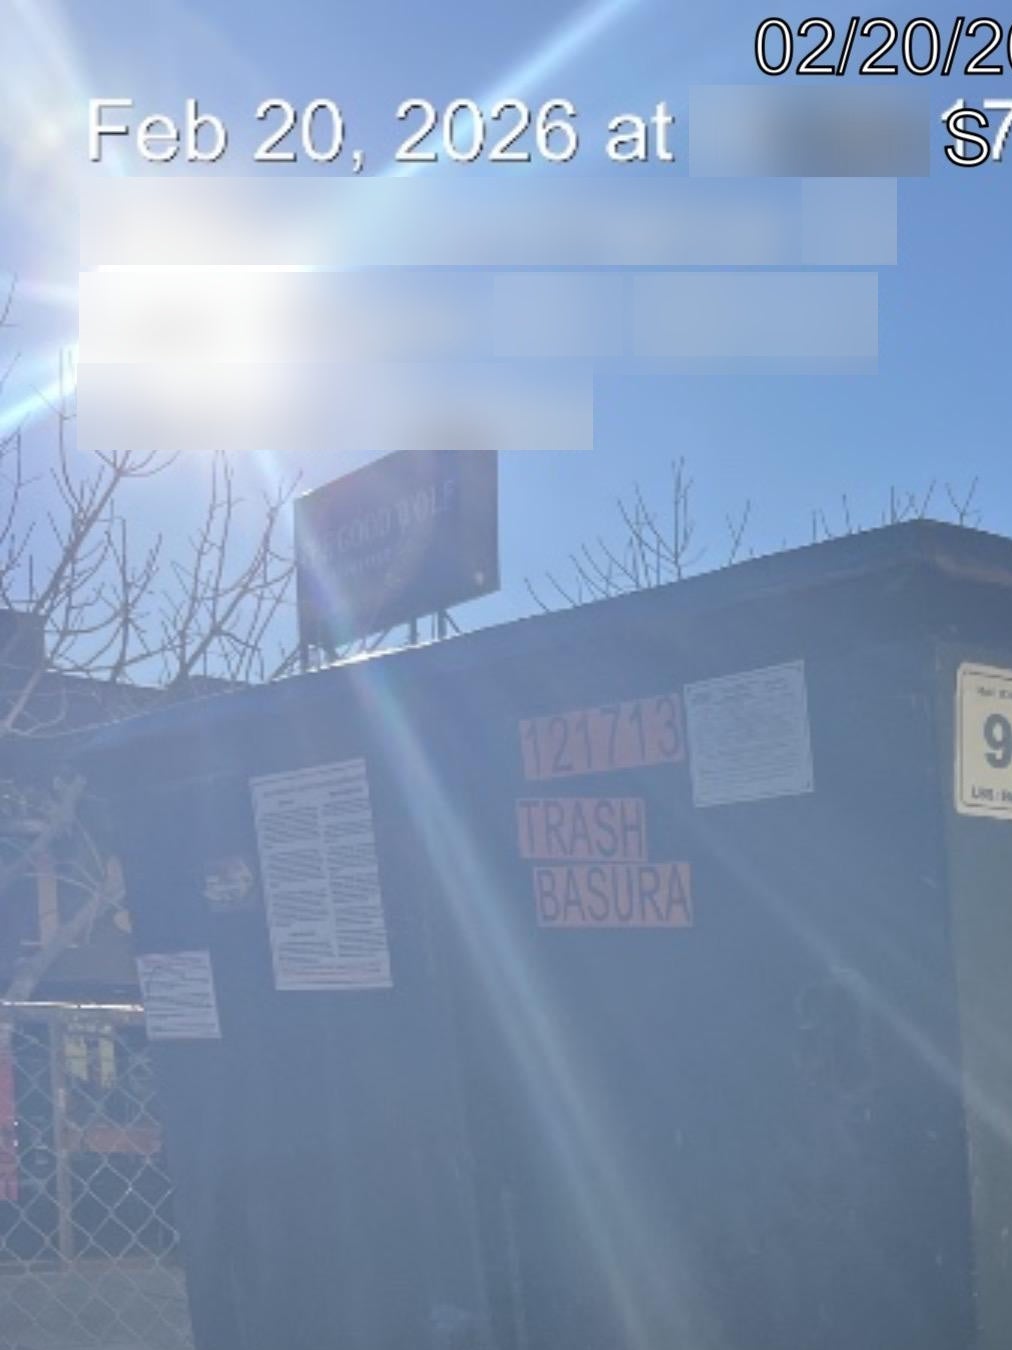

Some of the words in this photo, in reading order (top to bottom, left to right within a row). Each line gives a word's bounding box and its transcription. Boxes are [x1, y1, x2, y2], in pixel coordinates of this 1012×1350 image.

[522, 697, 682, 777] 121713
[520, 800, 644, 858] TRASH
[536, 864, 691, 922] BASURA
